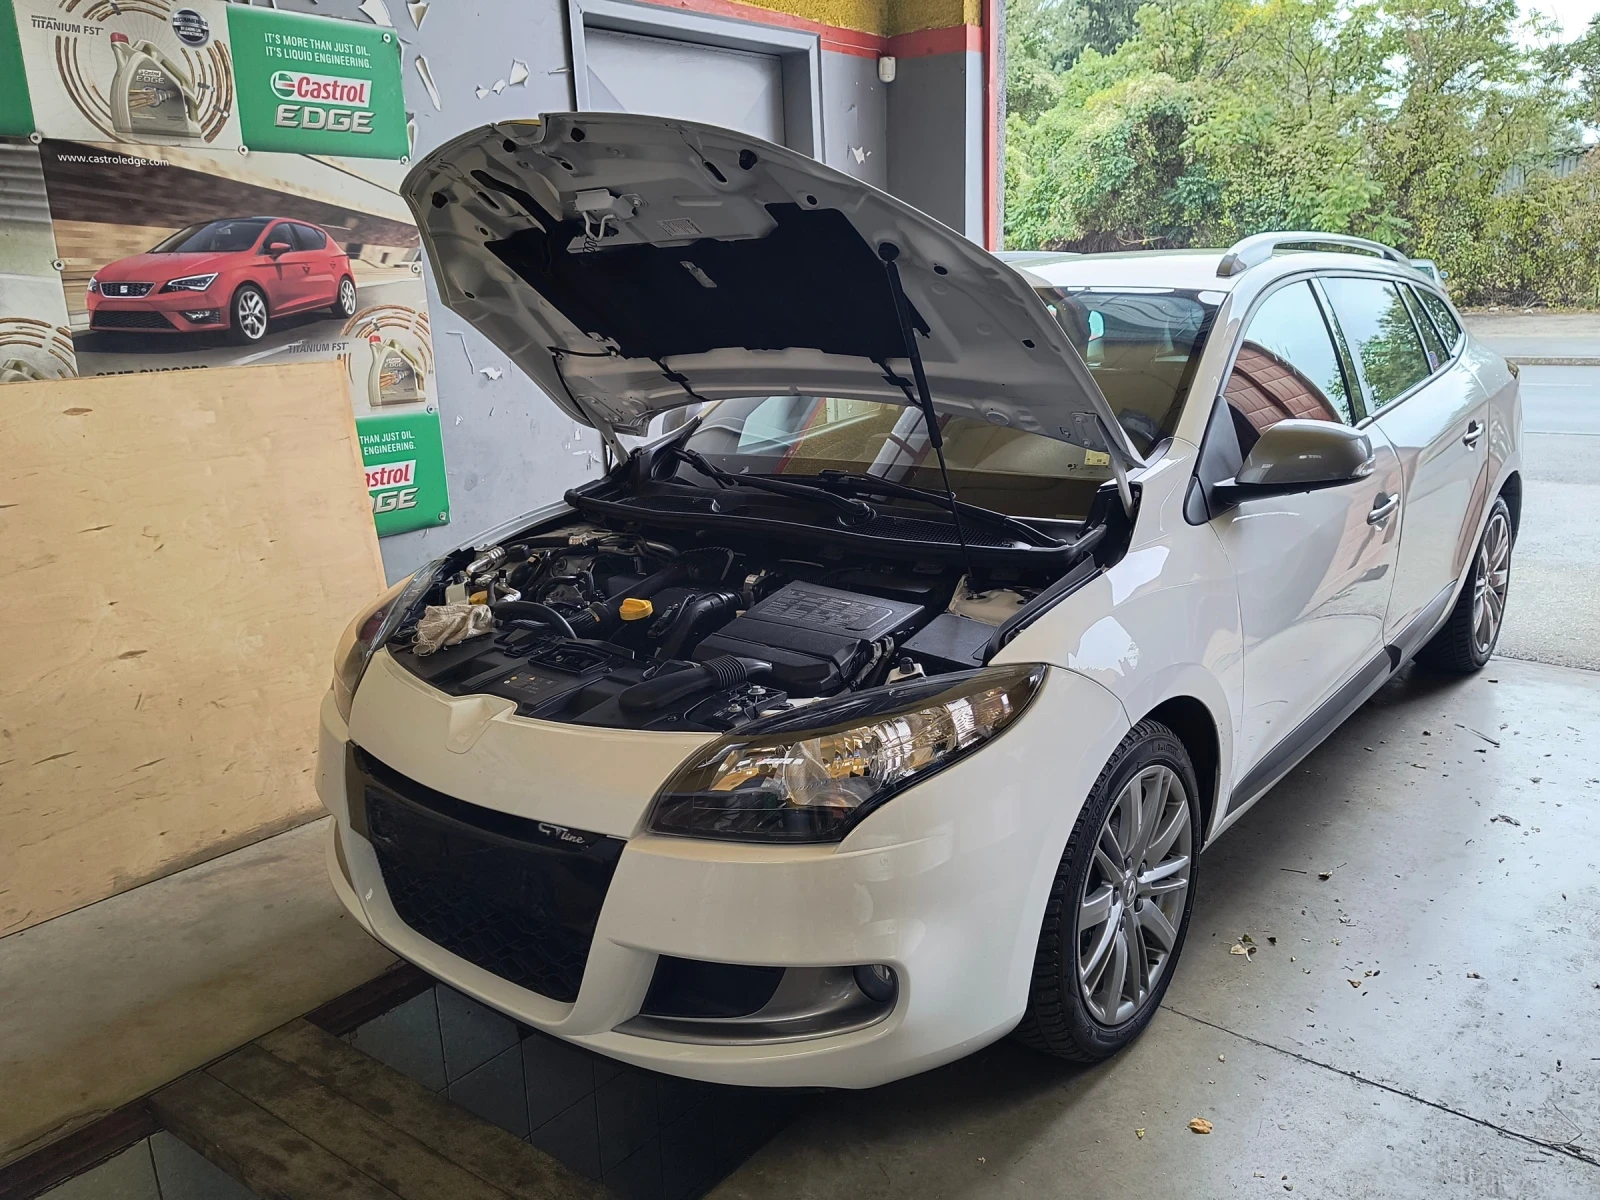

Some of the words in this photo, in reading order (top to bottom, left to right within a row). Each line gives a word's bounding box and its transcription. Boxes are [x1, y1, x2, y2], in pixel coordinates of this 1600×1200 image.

[31, 19, 80, 33] TITANIUM
[264, 33, 281, 44] IT'S
[283, 35, 308, 48] MORE
[310, 38, 332, 51] THAN
[334, 42, 353, 54] JUST
[355, 45, 371, 56] OIL.
[265, 46, 282, 57] IT'S
[284, 48, 313, 61] LIQUID
[315, 52, 372, 69] ENGINEERING.
[297, 76, 365, 103] Castrol
[274, 104, 376, 134] EDGE
[57, 154, 169, 167] www.castroledge.com
[288, 342, 329, 353] TITANIUM
[359, 434, 380, 445] THAN
[381, 432, 400, 443] JUST
[401, 430, 416, 440] OIL.
[363, 441, 417, 456] ENGINEERING.
[365, 464, 410, 487] strol
[370, 487, 419, 514] GE
[560, 831, 585, 844] Line
